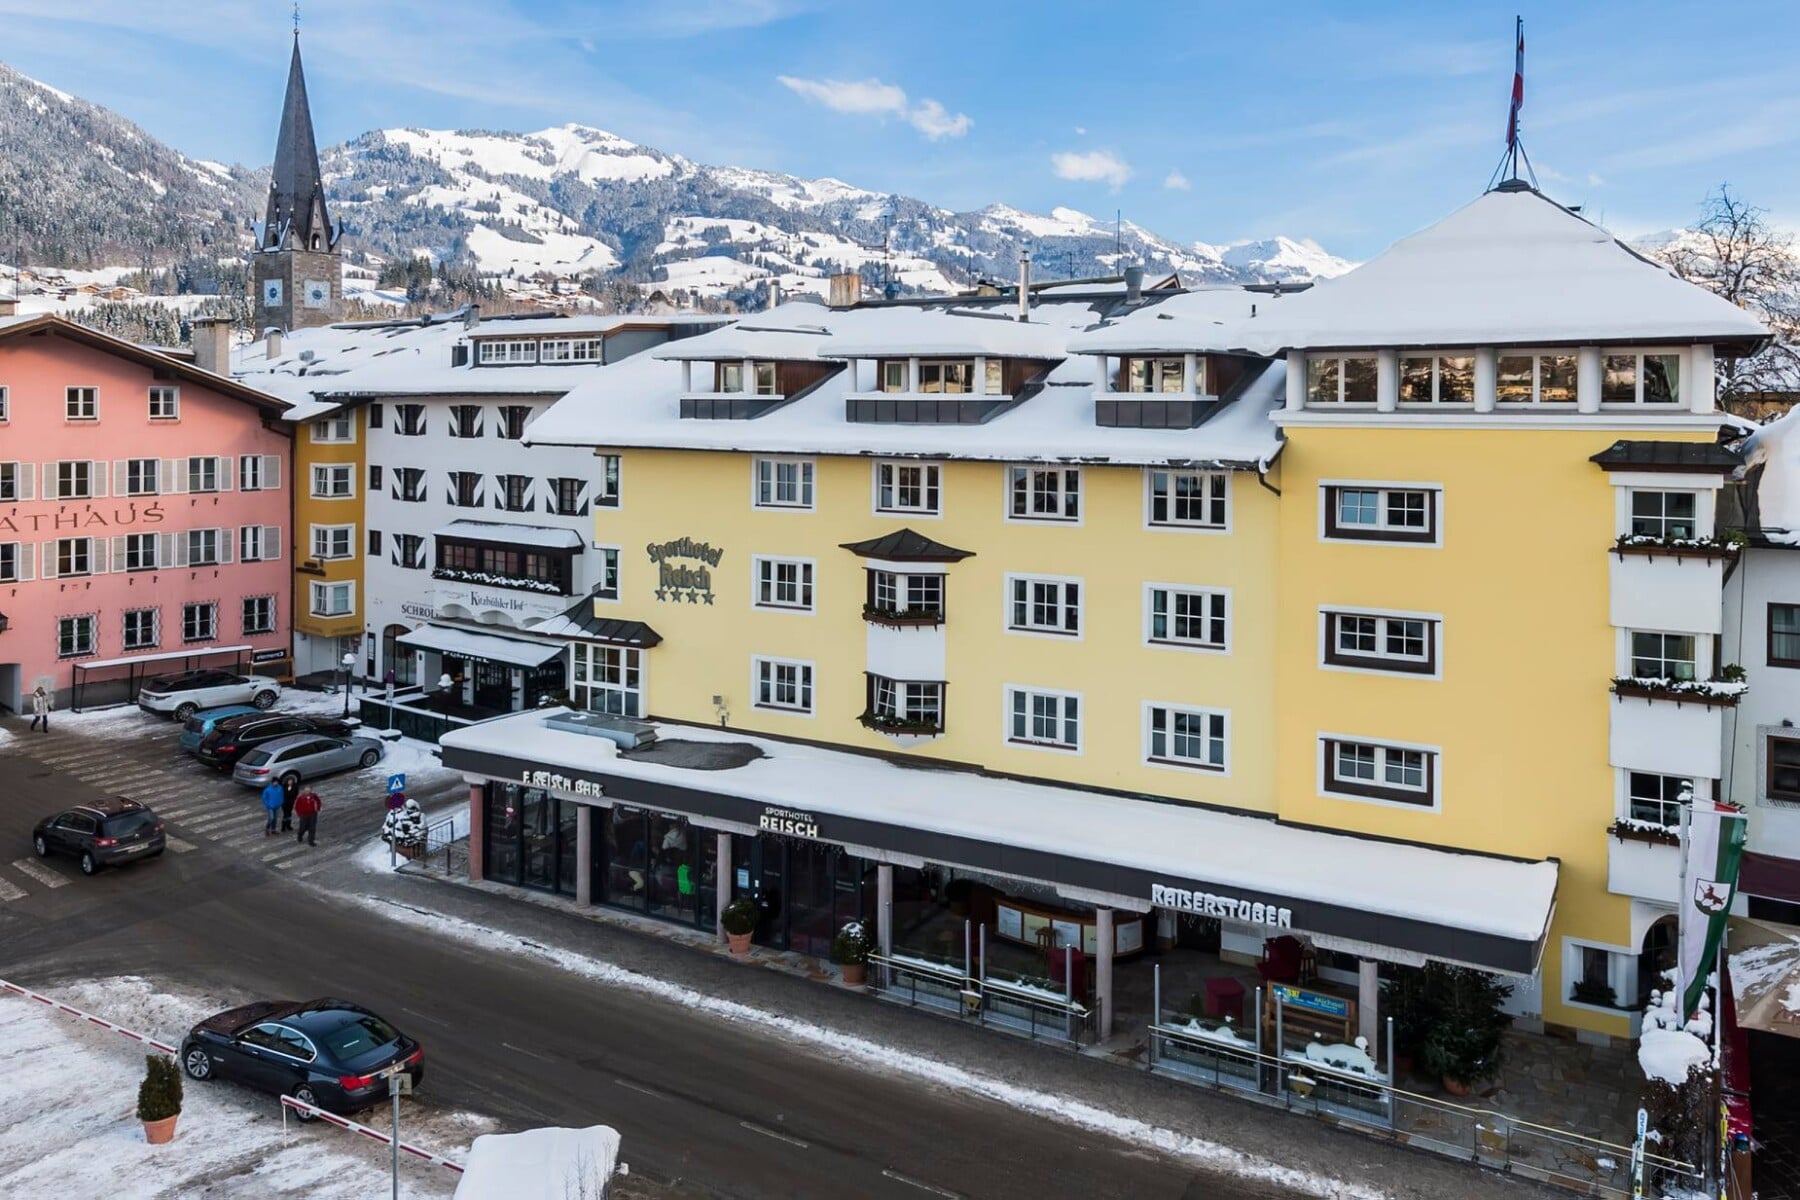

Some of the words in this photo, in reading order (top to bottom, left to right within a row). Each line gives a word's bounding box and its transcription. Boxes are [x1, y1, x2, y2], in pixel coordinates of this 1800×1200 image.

[646, 536, 724, 568] Sporthotel
[532, 768, 572, 792] REISCH
[575, 779, 602, 798] BAR
[760, 815, 818, 838] REISCH
[765, 806, 815, 823] SPORTHOTEL
[1151, 883, 1292, 929] KAISERSTUBEN
